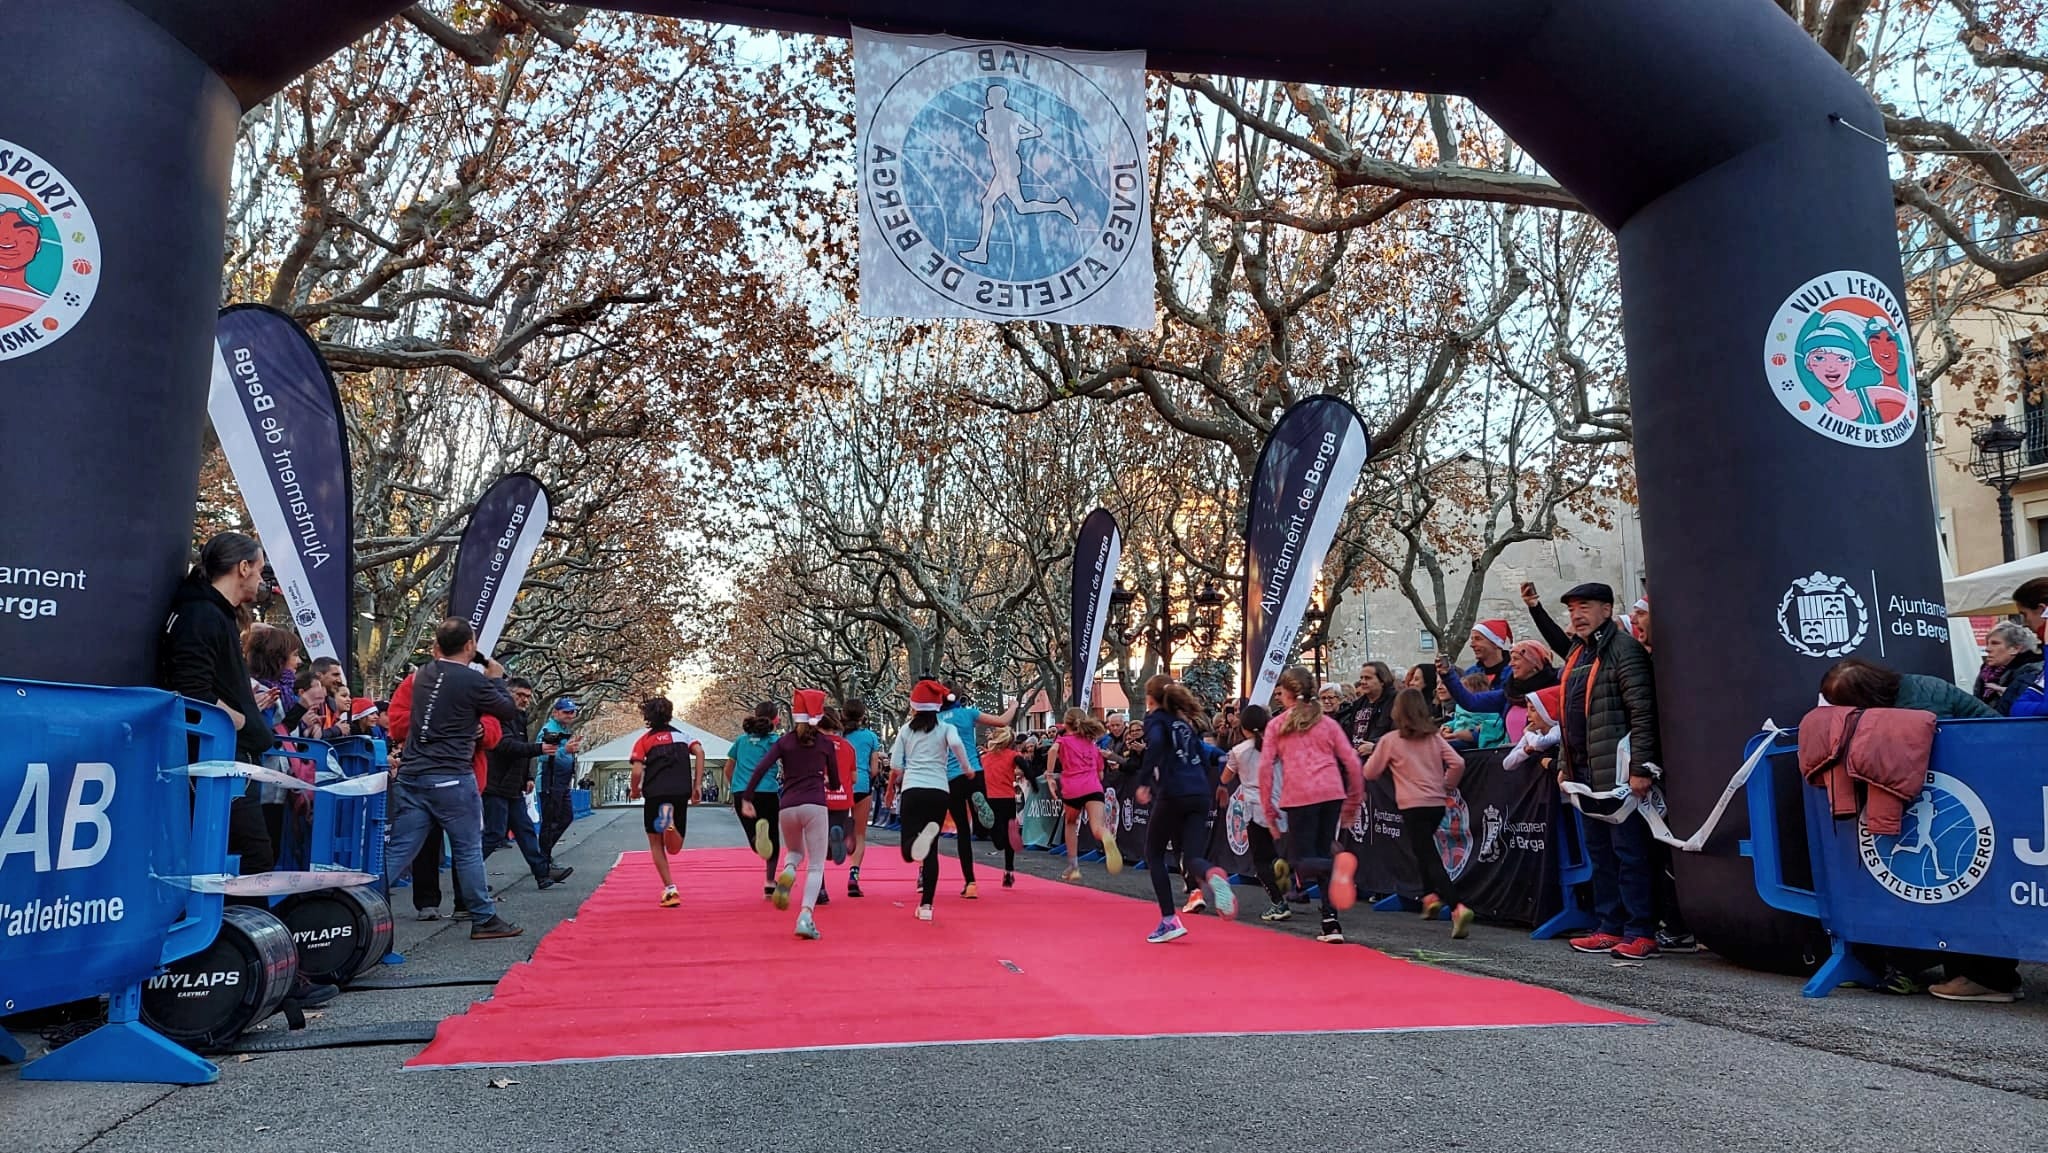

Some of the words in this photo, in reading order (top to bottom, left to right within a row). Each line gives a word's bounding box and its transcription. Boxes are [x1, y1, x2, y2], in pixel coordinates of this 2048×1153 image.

[1791, 281, 1838, 314] VULL
[1847, 277, 1904, 329] L'ESPORT
[1817, 413, 1862, 441] LLIURE
[1865, 428, 1880, 444] DE
[1881, 415, 1912, 444] SEXISME
[1304, 431, 1337, 485] Berga
[1298, 487, 1315, 511] de
[497, 503, 526, 550] Berga
[490, 553, 505, 572] de
[1095, 535, 1109, 573] Berga
[1259, 514, 1306, 615] Ajuntament
[1091, 573, 1100, 590] de
[0, 596, 57, 620] rga
[1079, 592, 1097, 662] Ajuntament
[1891, 618, 1913, 636] de
[1916, 619, 1949, 643] Berga
[1878, 870, 1943, 901] ATLETES
[1948, 877, 1970, 896] DE
[1968, 825, 1991, 878] BERGA
[147, 970, 240, 990] MYLAPS
